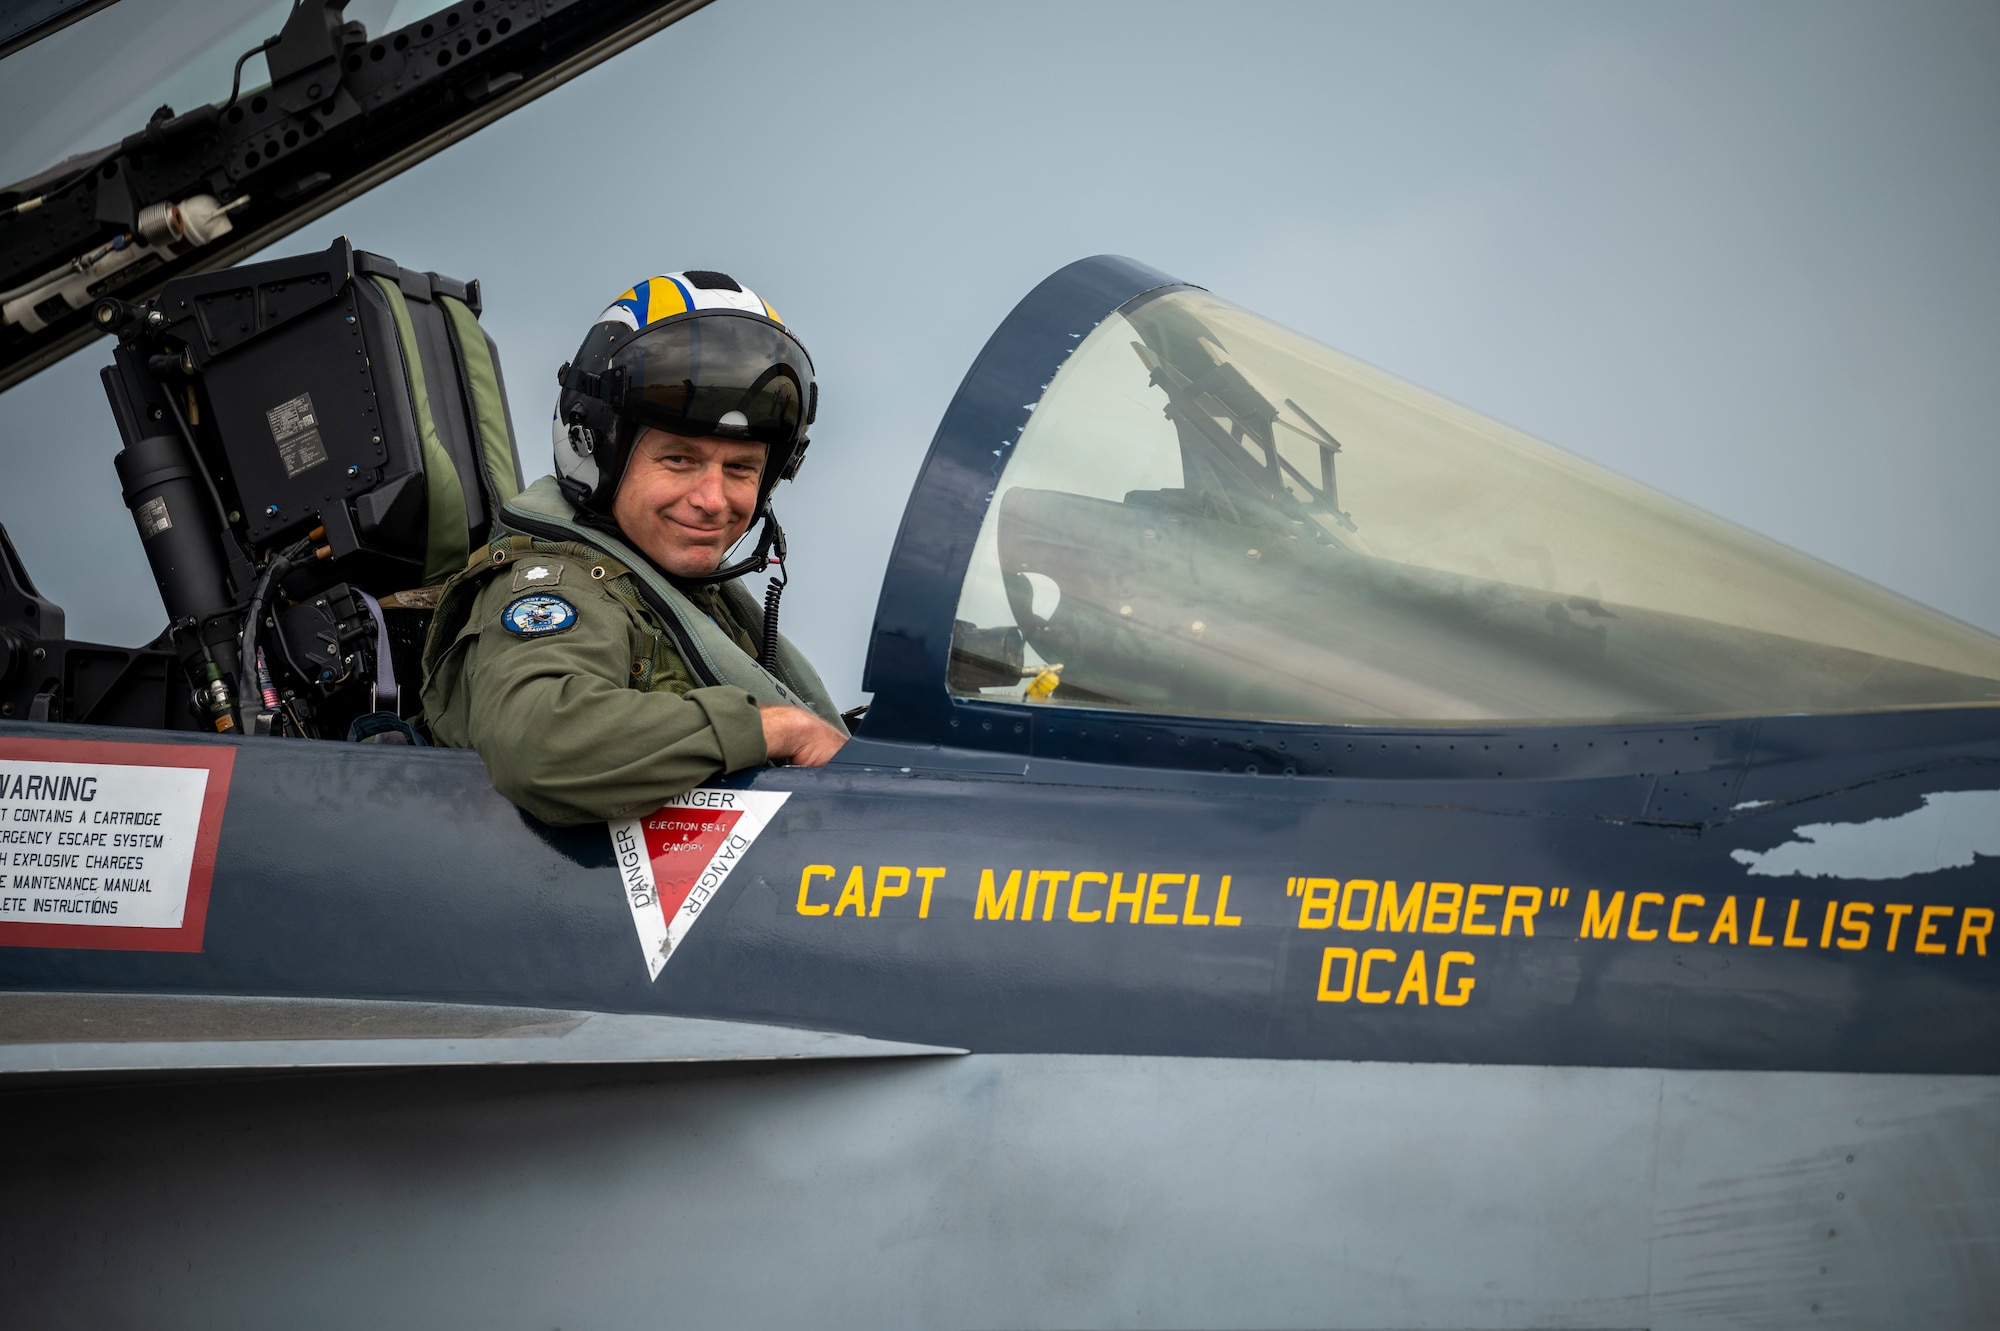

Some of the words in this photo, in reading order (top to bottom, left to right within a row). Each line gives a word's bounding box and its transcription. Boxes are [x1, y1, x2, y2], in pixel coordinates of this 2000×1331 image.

[13, 808, 73, 823] CONTAINS
[79, 811, 87, 824] A
[93, 811, 163, 826] CARTRIDGE
[649, 820, 700, 831] EJECTION
[700, 823, 727, 832] SEAT
[58, 832, 108, 847] ESCAPE
[113, 834, 164, 848] SYSTEM
[662, 842, 705, 853] CANOPY
[13, 853, 80, 868] EXPLOSIVE
[86, 855, 144, 870] CHARGES
[616, 826, 651, 909] DANGER
[13, 875, 98, 891] MAINTENANCE
[104, 878, 152, 892] MANUAL
[682, 834, 747, 916] DANGER
[33, 898, 119, 914] INSTRUCTIONS
[795, 864, 947, 921] CAPT
[973, 868, 1242, 927] MITCHELL
[1286, 876, 1570, 937] "BOMBER"
[1579, 889, 1995, 956] MCCALLISTER
[1316, 946, 1476, 1007] DCAG
